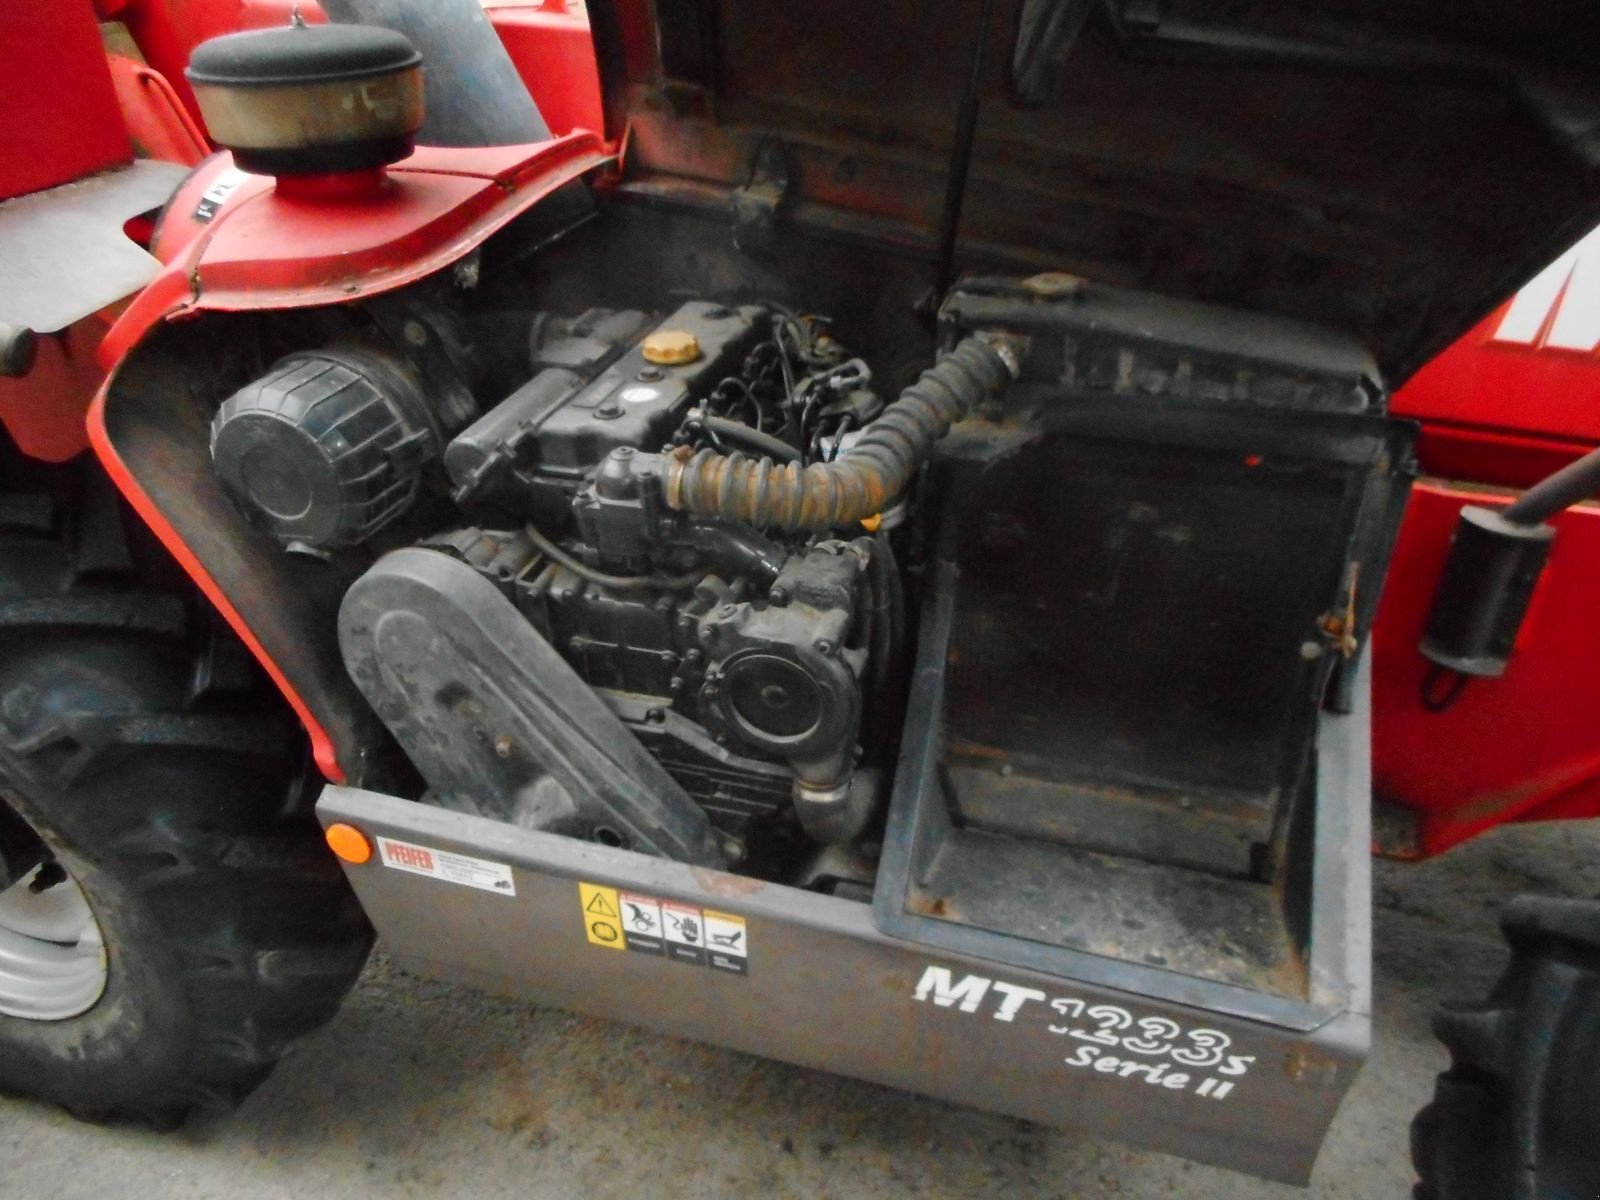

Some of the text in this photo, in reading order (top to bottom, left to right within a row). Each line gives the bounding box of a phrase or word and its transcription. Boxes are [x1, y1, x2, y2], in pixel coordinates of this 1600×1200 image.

[384, 841, 434, 871] PFEIFER
[911, 966, 1047, 1022] MT
[1065, 1046, 1190, 1089] Serie
